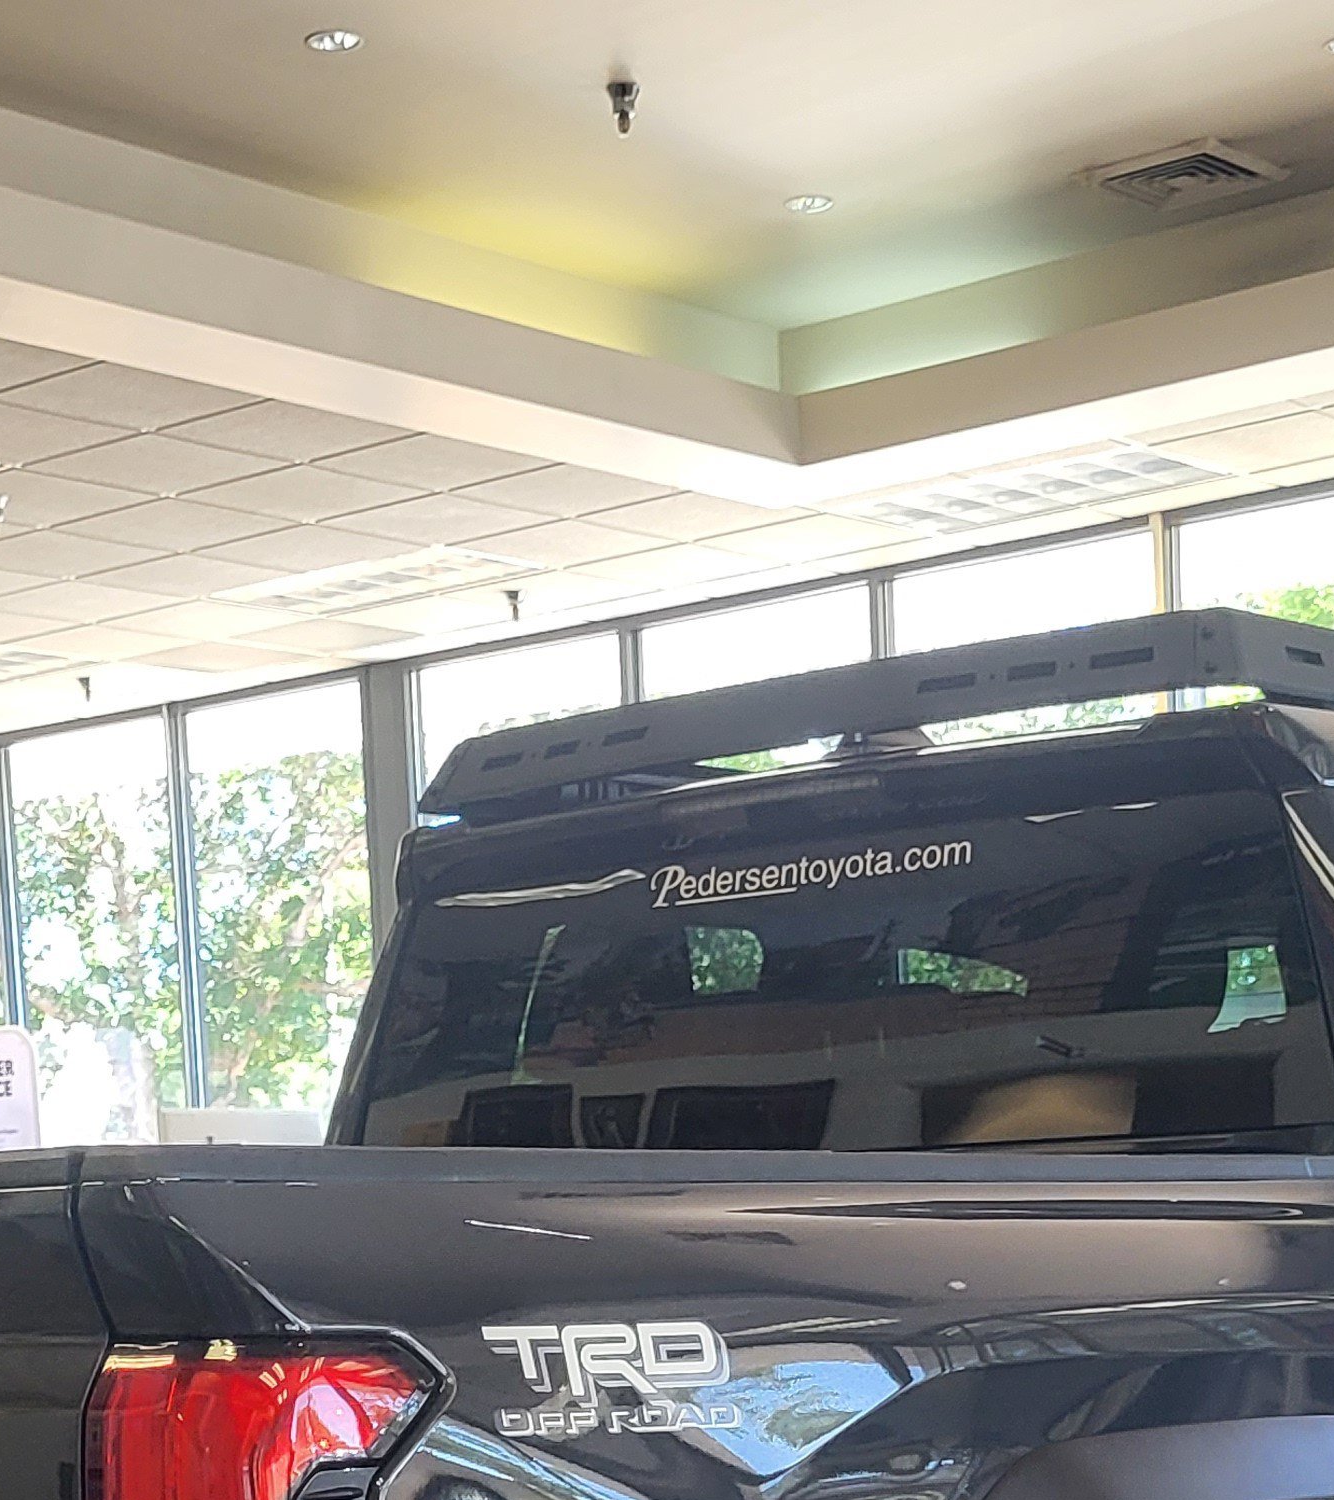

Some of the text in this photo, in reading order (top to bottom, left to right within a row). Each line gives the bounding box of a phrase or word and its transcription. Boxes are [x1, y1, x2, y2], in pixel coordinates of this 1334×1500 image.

[651, 841, 972, 908] Pedersentoyota.com
[481, 1321, 729, 1408] TRD
[494, 1400, 745, 1437] OFF ROAD
